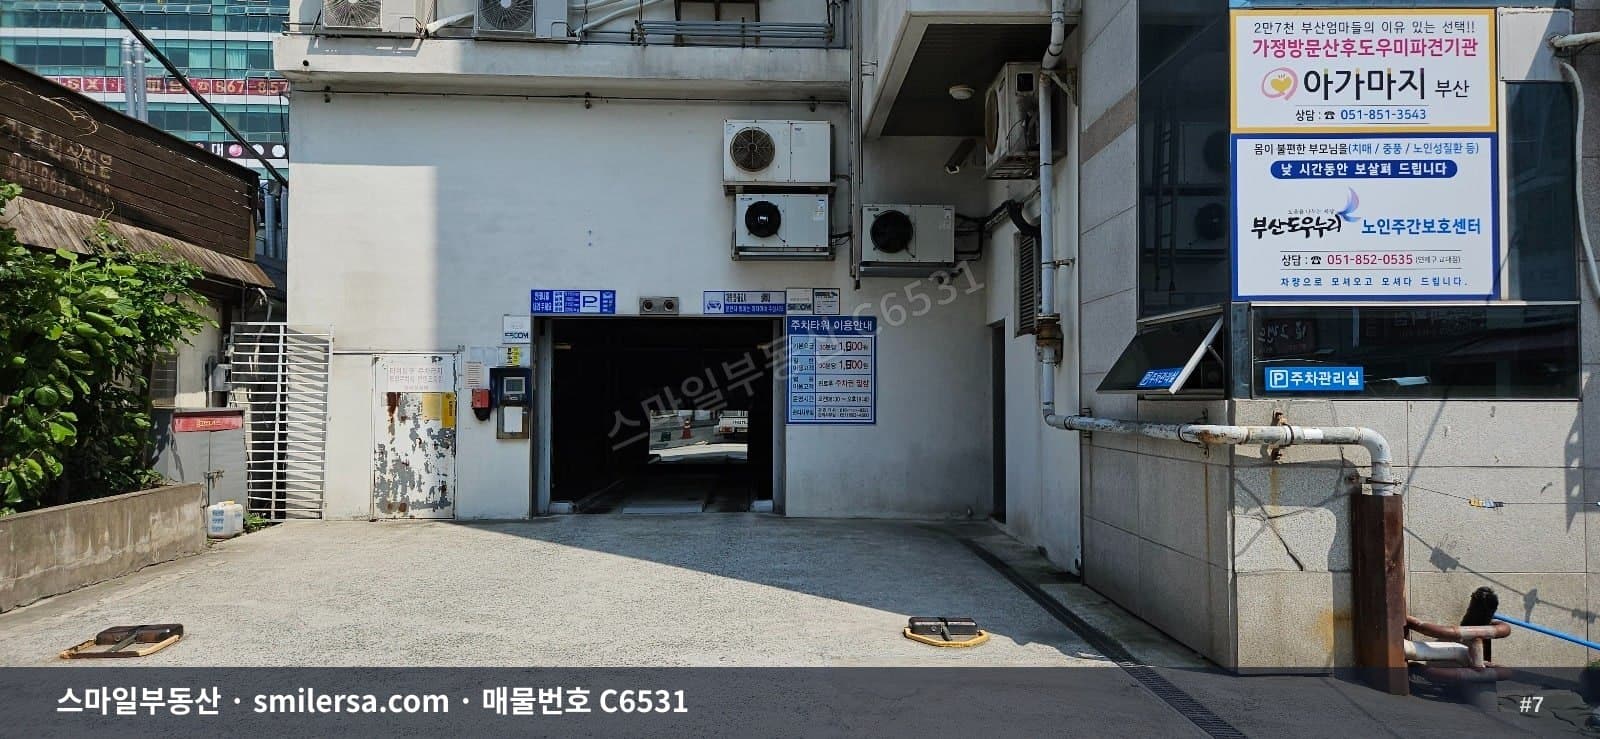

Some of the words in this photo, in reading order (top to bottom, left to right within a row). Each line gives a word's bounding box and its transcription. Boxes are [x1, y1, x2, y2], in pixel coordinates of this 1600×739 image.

[1254, 22, 1295, 34] 2만7천
[1301, 21, 1374, 35] 부산엄마들의
[1382, 21, 1406, 34] 이유
[1412, 21, 1436, 34] 있는
[1442, 20, 1476, 34] 선택!!
[1252, 38, 1478, 58] 가정방문산후도우미파견기관
[1303, 67, 1425, 101] 아가마지
[1434, 80, 1470, 99] 부산
[1295, 109, 1315, 122] 상담
[1340, 109, 1427, 121] 051-851-3543
[1254, 143, 1274, 156] 몸이
[1277, 143, 1306, 156] 불편한
[1383, 143, 1403, 155] 중풍
[1413, 143, 1463, 155] 노인성질환
[1299, 163, 1349, 177] 시간동안
[1398, 163, 1448, 177] 드립니다
[1251, 214, 1342, 239] 부산도우누리
[1361, 218, 1481, 235] 노인주간보호센터
[1282, 255, 1301, 267] 상담
[1327, 254, 1413, 265] 051-852-0535
[1280, 277, 1323, 287] 차량으로
[1331, 277, 1373, 287] 모셔오고
[1381, 277, 1412, 287] 모셔다
[834, 319, 873, 332] 이용안내
[1290, 371, 1359, 386] 주차관리실
